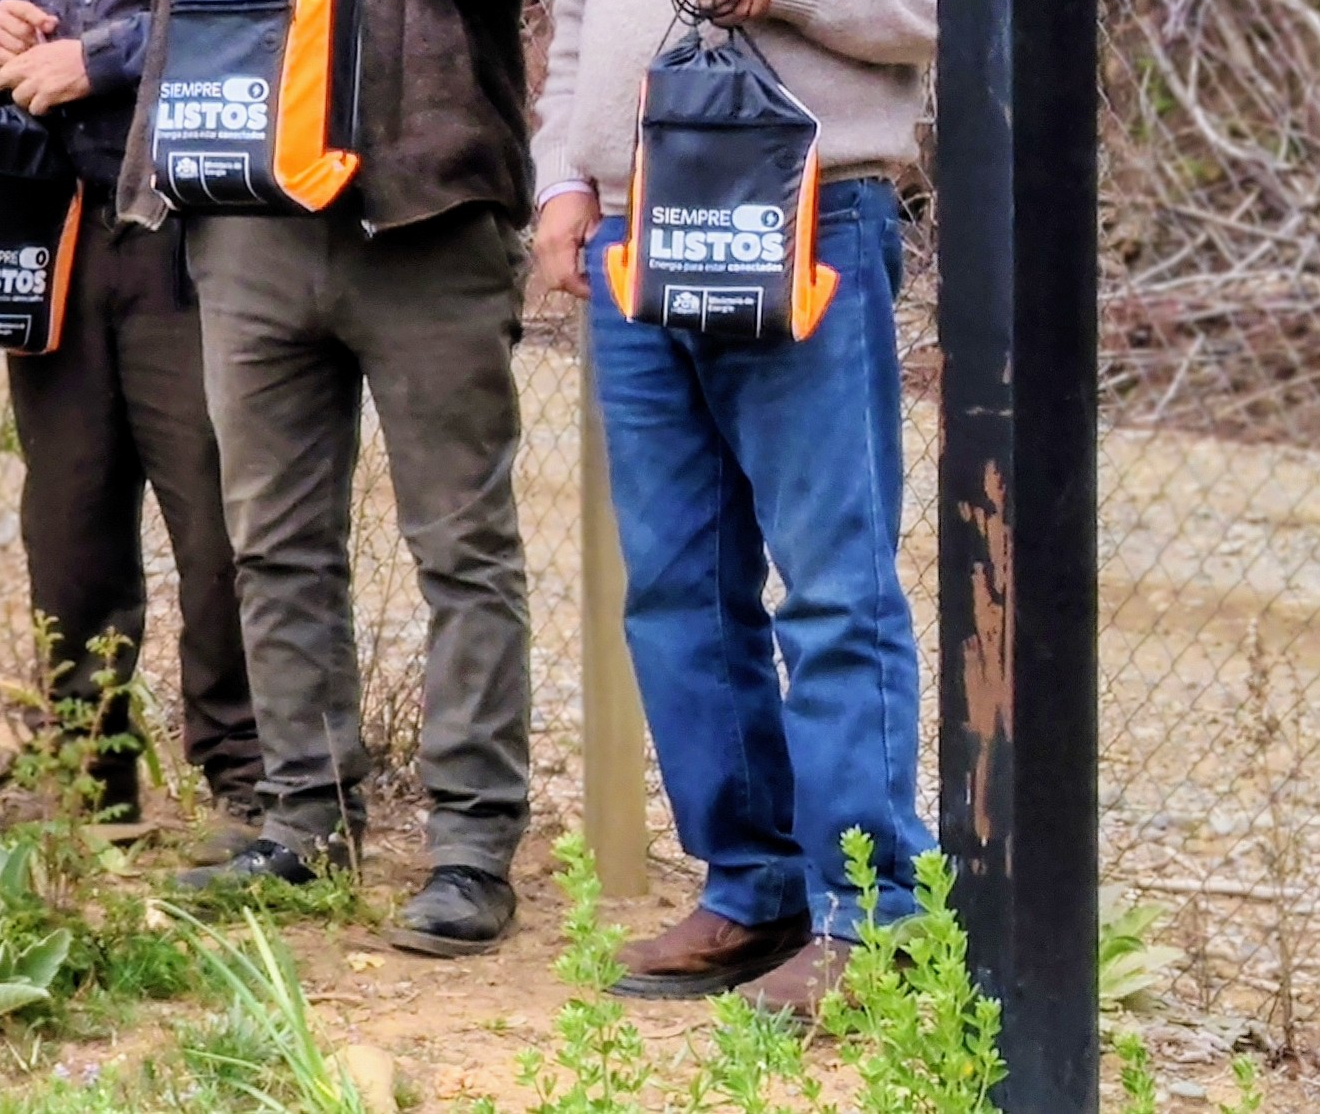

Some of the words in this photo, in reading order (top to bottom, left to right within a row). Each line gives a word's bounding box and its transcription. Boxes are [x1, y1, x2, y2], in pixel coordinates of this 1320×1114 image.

[160, 82, 222, 98] SIEMPRE
[158, 102, 268, 130] LISTOS
[652, 206, 731, 226] SIEMPRE
[650, 229, 784, 262] LISTOS
